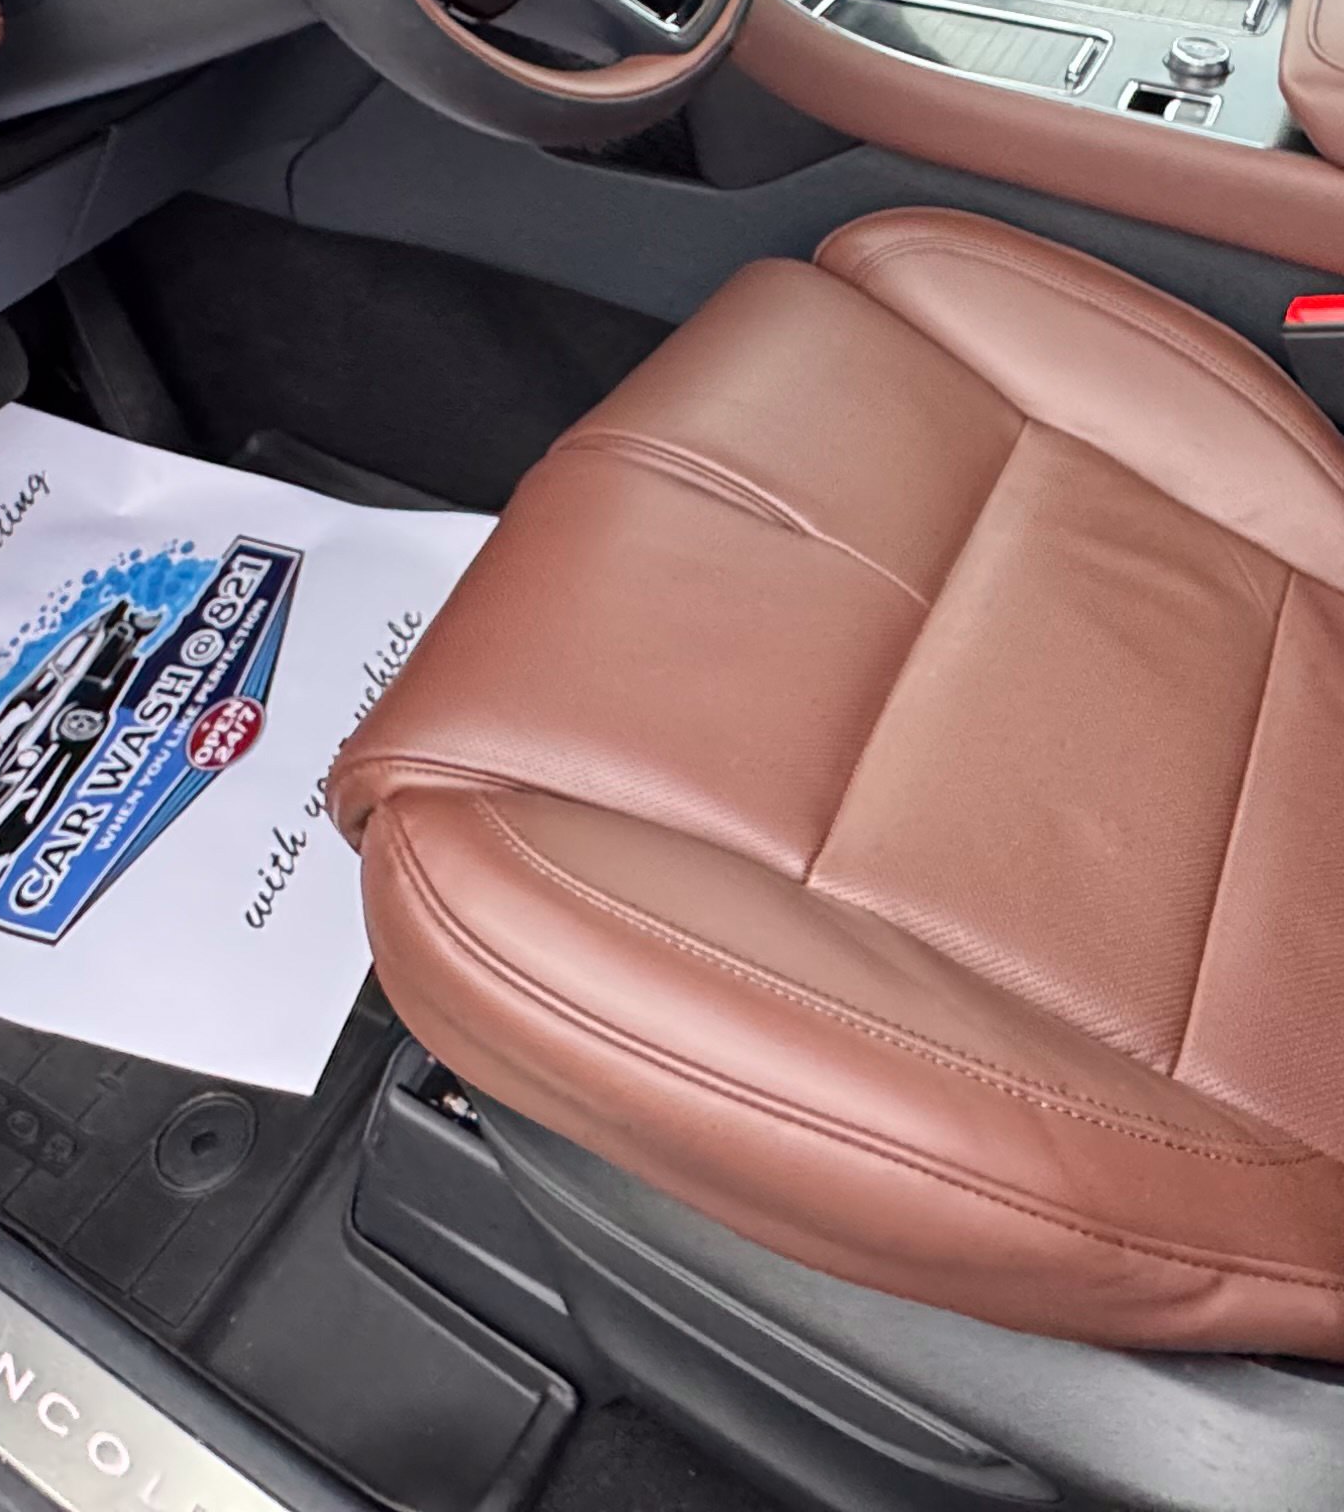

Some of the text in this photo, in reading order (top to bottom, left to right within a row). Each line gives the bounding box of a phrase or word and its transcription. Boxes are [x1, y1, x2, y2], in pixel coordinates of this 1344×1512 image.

[8, 553, 272, 916] CAR WASH @ 821
[94, 597, 269, 853] WHEN YOU LIKE PERFECTION
[193, 699, 258, 765] OPEN 24/7
[245, 826, 307, 930] with
